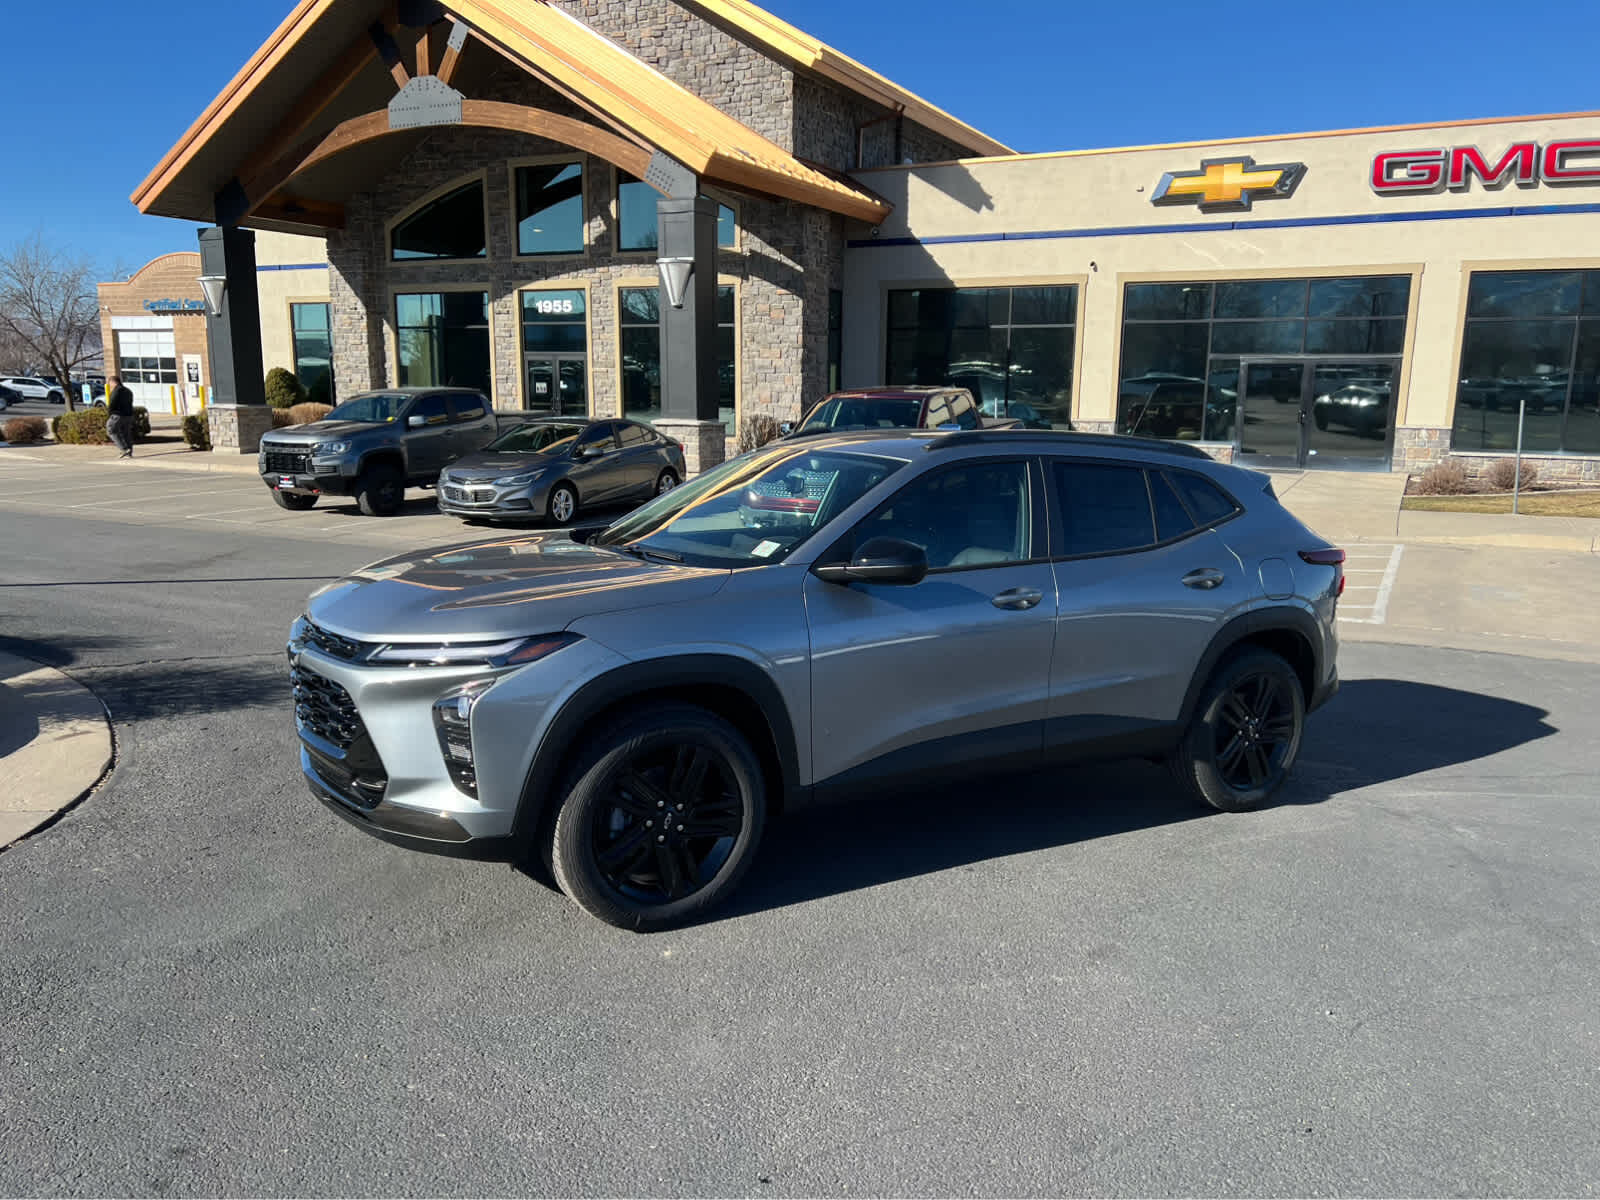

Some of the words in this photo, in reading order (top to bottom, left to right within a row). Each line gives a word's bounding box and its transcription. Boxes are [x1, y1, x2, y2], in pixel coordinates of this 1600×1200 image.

[1369, 138, 1600, 192] GMC
[143, 298, 182, 311] Certified
[184, 298, 205, 311] Serv
[535, 299, 573, 314] 1955
